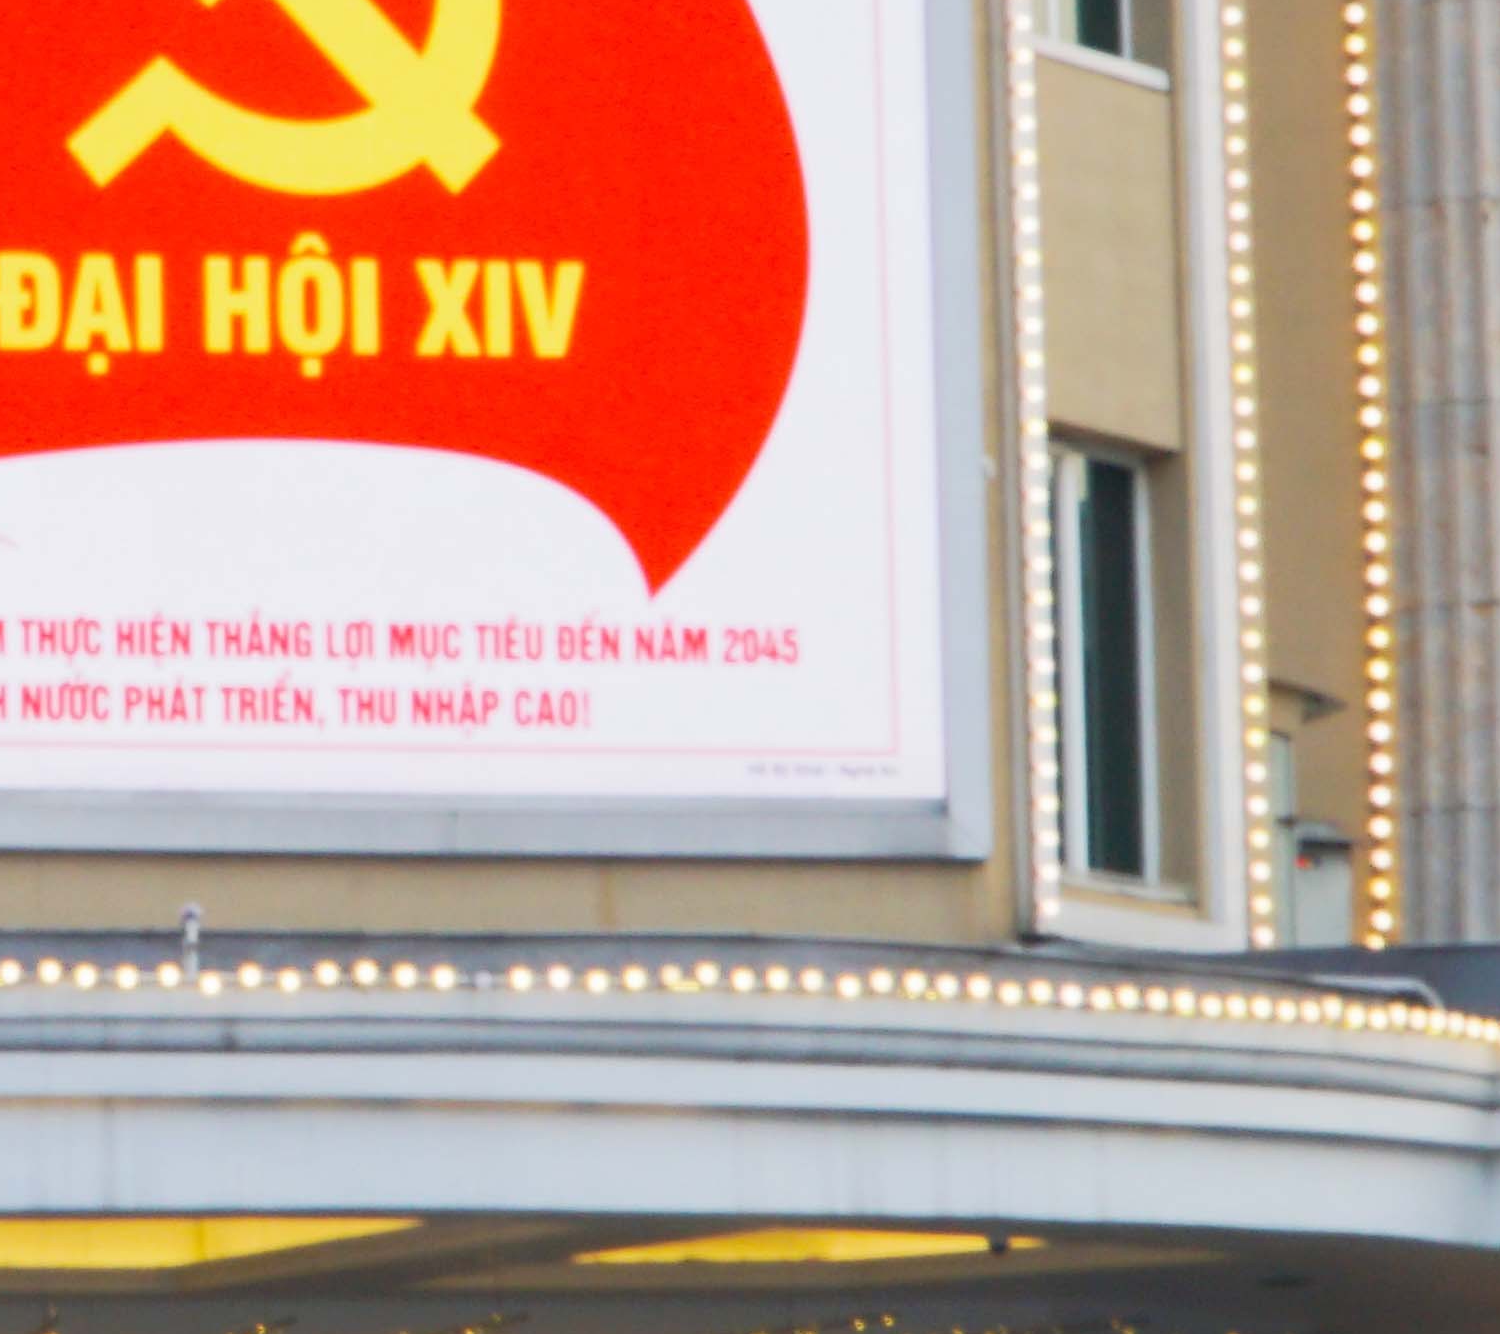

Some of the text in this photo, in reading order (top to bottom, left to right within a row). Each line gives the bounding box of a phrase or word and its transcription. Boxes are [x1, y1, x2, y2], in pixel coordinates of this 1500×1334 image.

[203, 230, 381, 378] HỘI
[415, 257, 585, 359] XIV
[21, 615, 101, 664] THỰC
[117, 611, 191, 667] HIỆN
[326, 621, 374, 668] LỢI
[389, 624, 461, 670] MỤC
[476, 615, 543, 661] TIÊU
[557, 609, 620, 661] ĐẾN
[723, 627, 799, 664] 2045
[21, 673, 110, 721] NƯỚC
[125, 676, 206, 721] PHÁT
[338, 687, 397, 725] THU
[412, 681, 498, 737] NHẬP
[514, 690, 591, 727] CAO!
